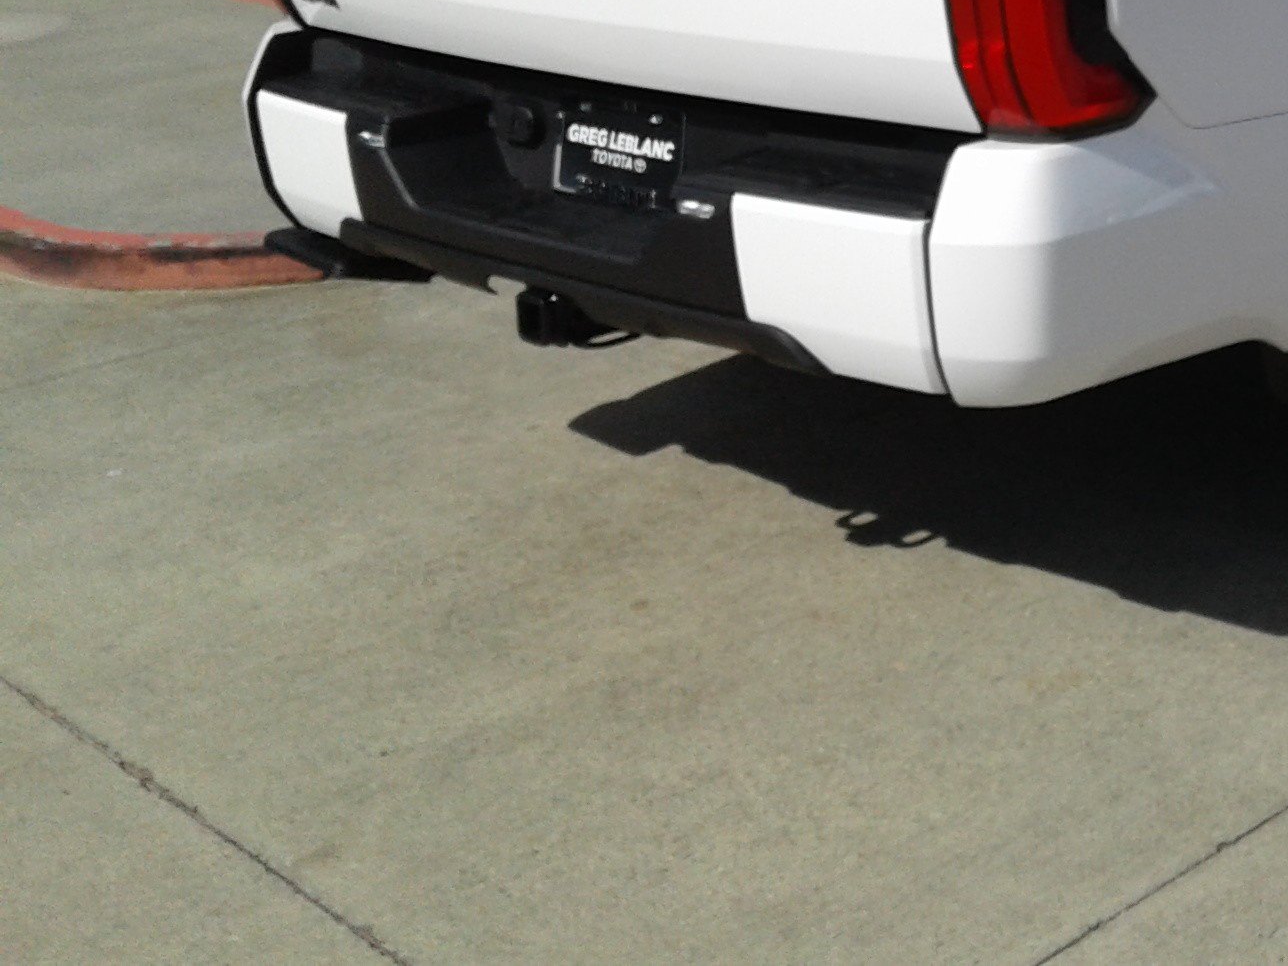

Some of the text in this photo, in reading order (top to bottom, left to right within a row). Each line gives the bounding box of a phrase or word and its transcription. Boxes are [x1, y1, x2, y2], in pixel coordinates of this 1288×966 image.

[567, 123, 675, 162] GREG LEBLANC
[592, 148, 633, 171] TOYOTA
